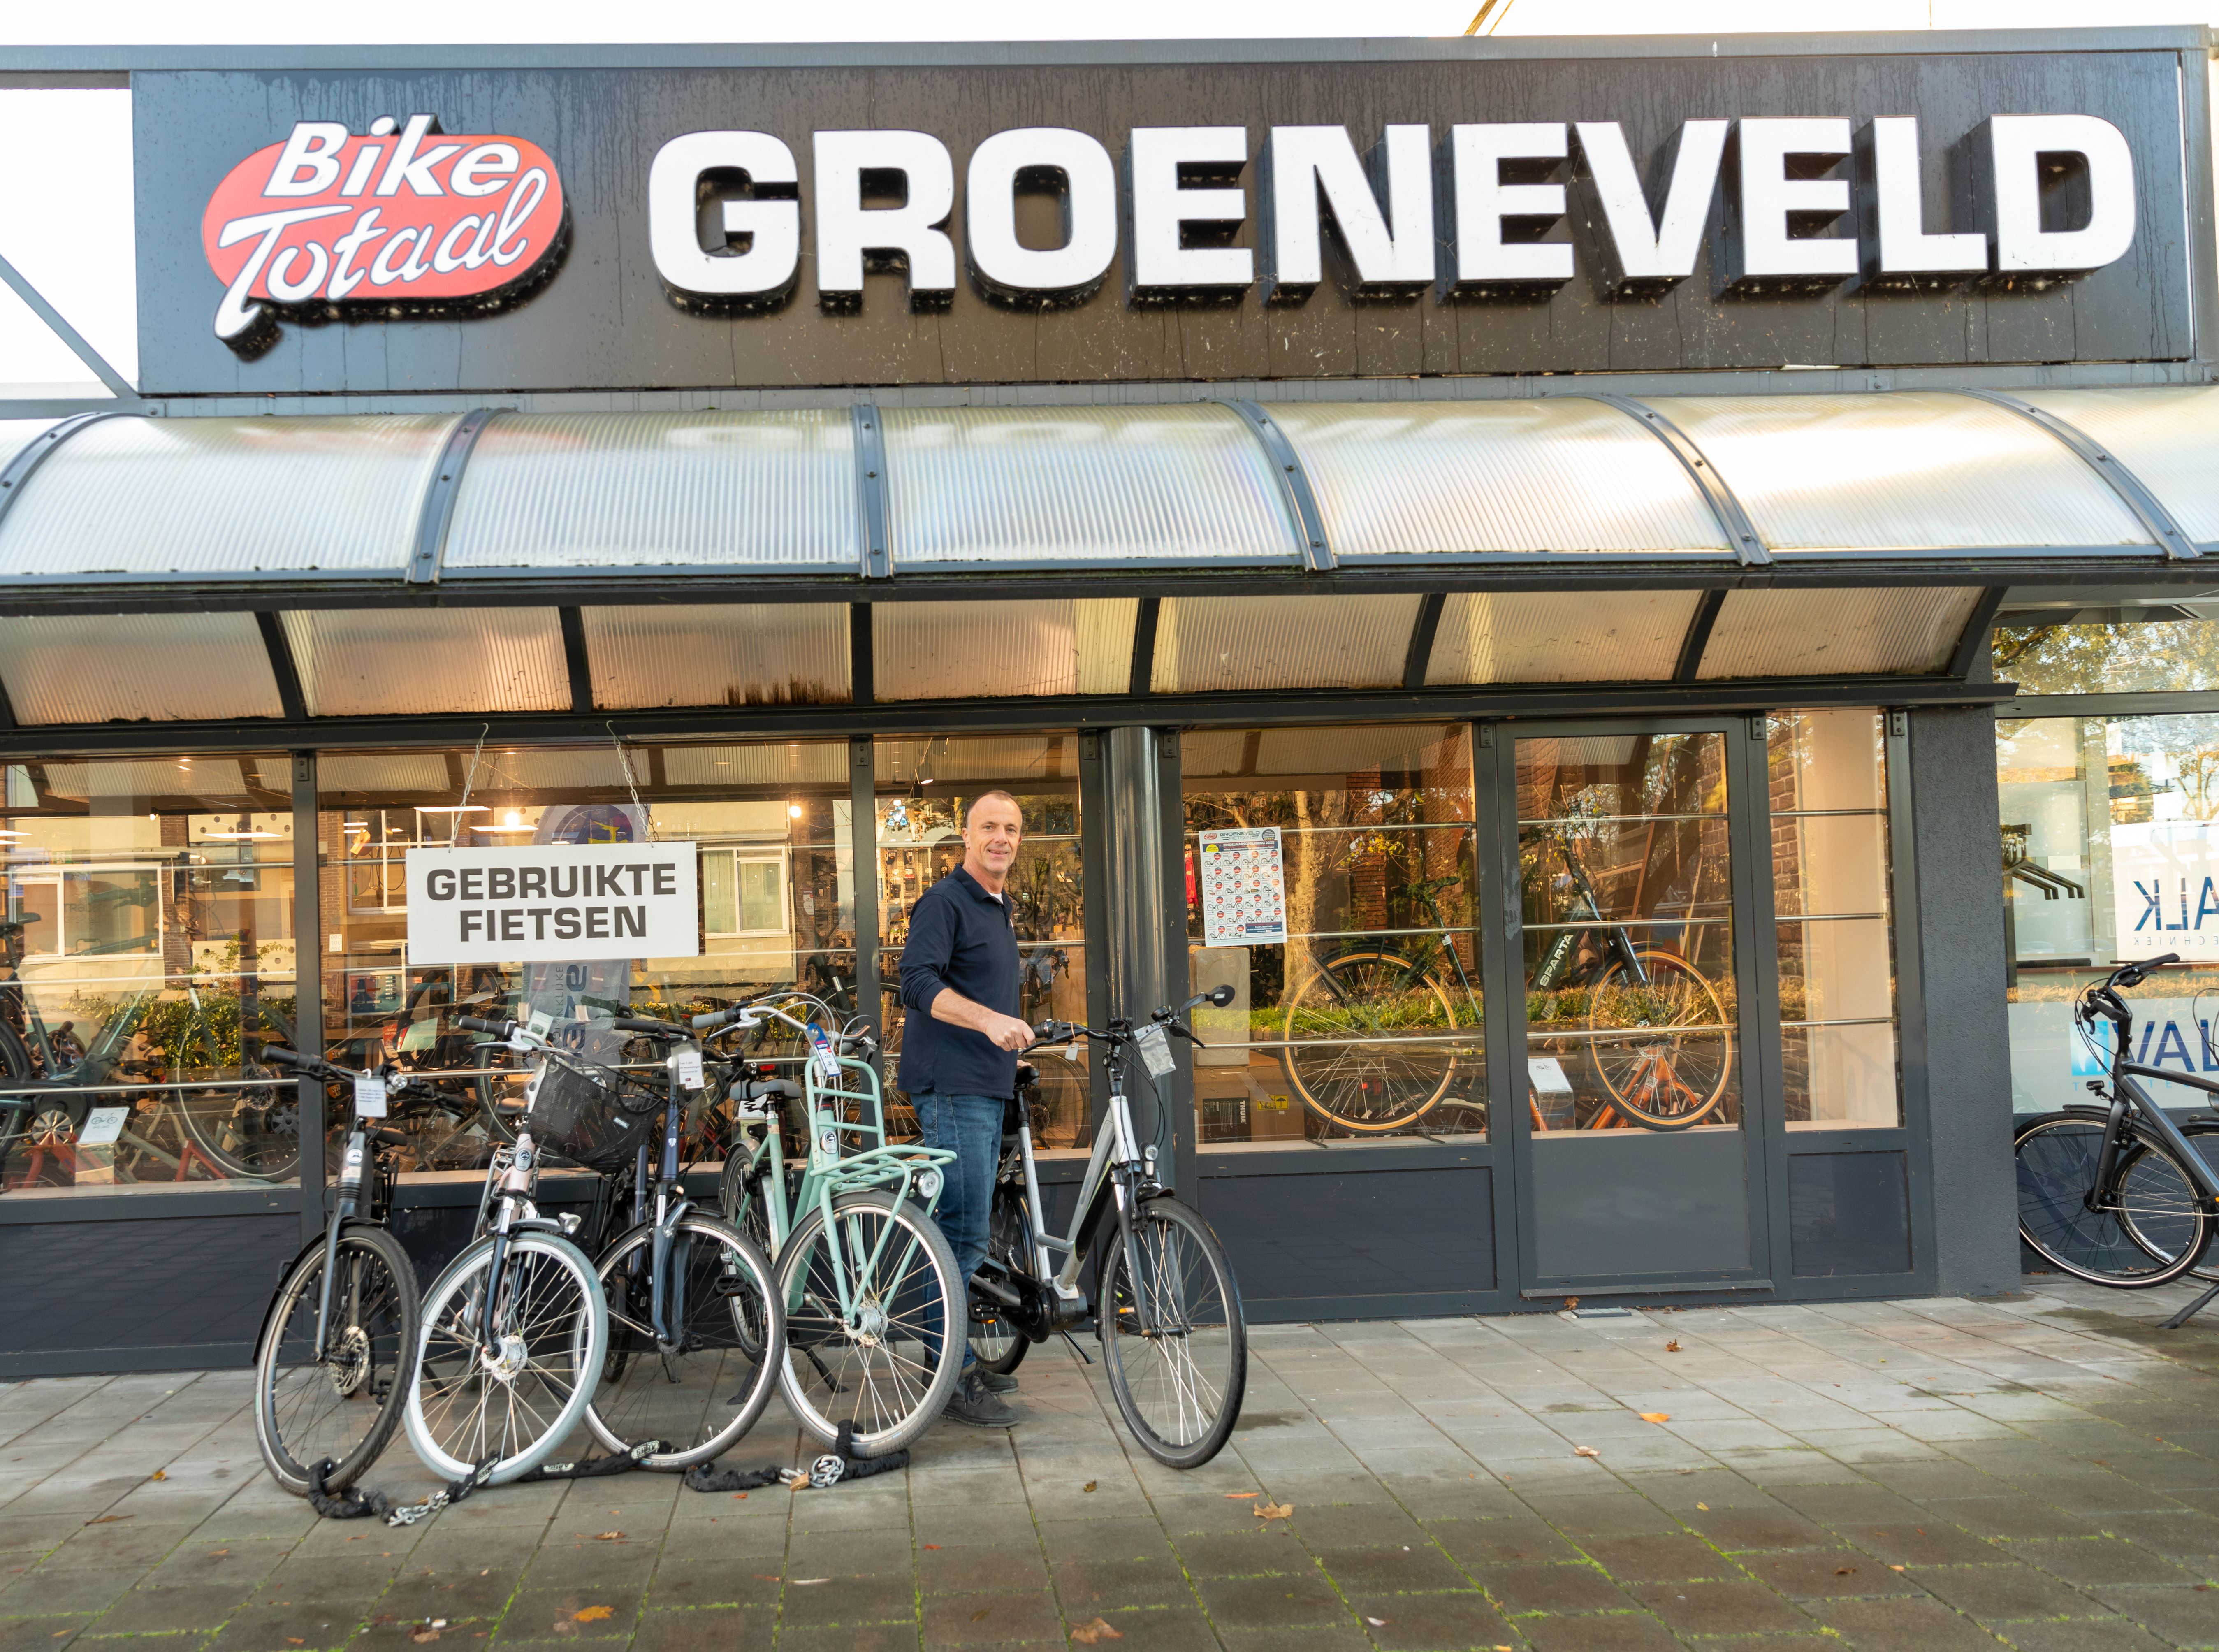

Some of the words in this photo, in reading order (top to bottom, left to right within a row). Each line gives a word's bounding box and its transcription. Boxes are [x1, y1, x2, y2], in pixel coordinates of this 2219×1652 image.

[261, 113, 521, 198] Bike
[648, 114, 2137, 293] GROENEVELD
[213, 168, 549, 339] Totaal
[427, 863, 677, 901] GEBRUIKTE
[460, 905, 647, 942] FIETSEN
[1539, 934, 1574, 987] SPARTA
